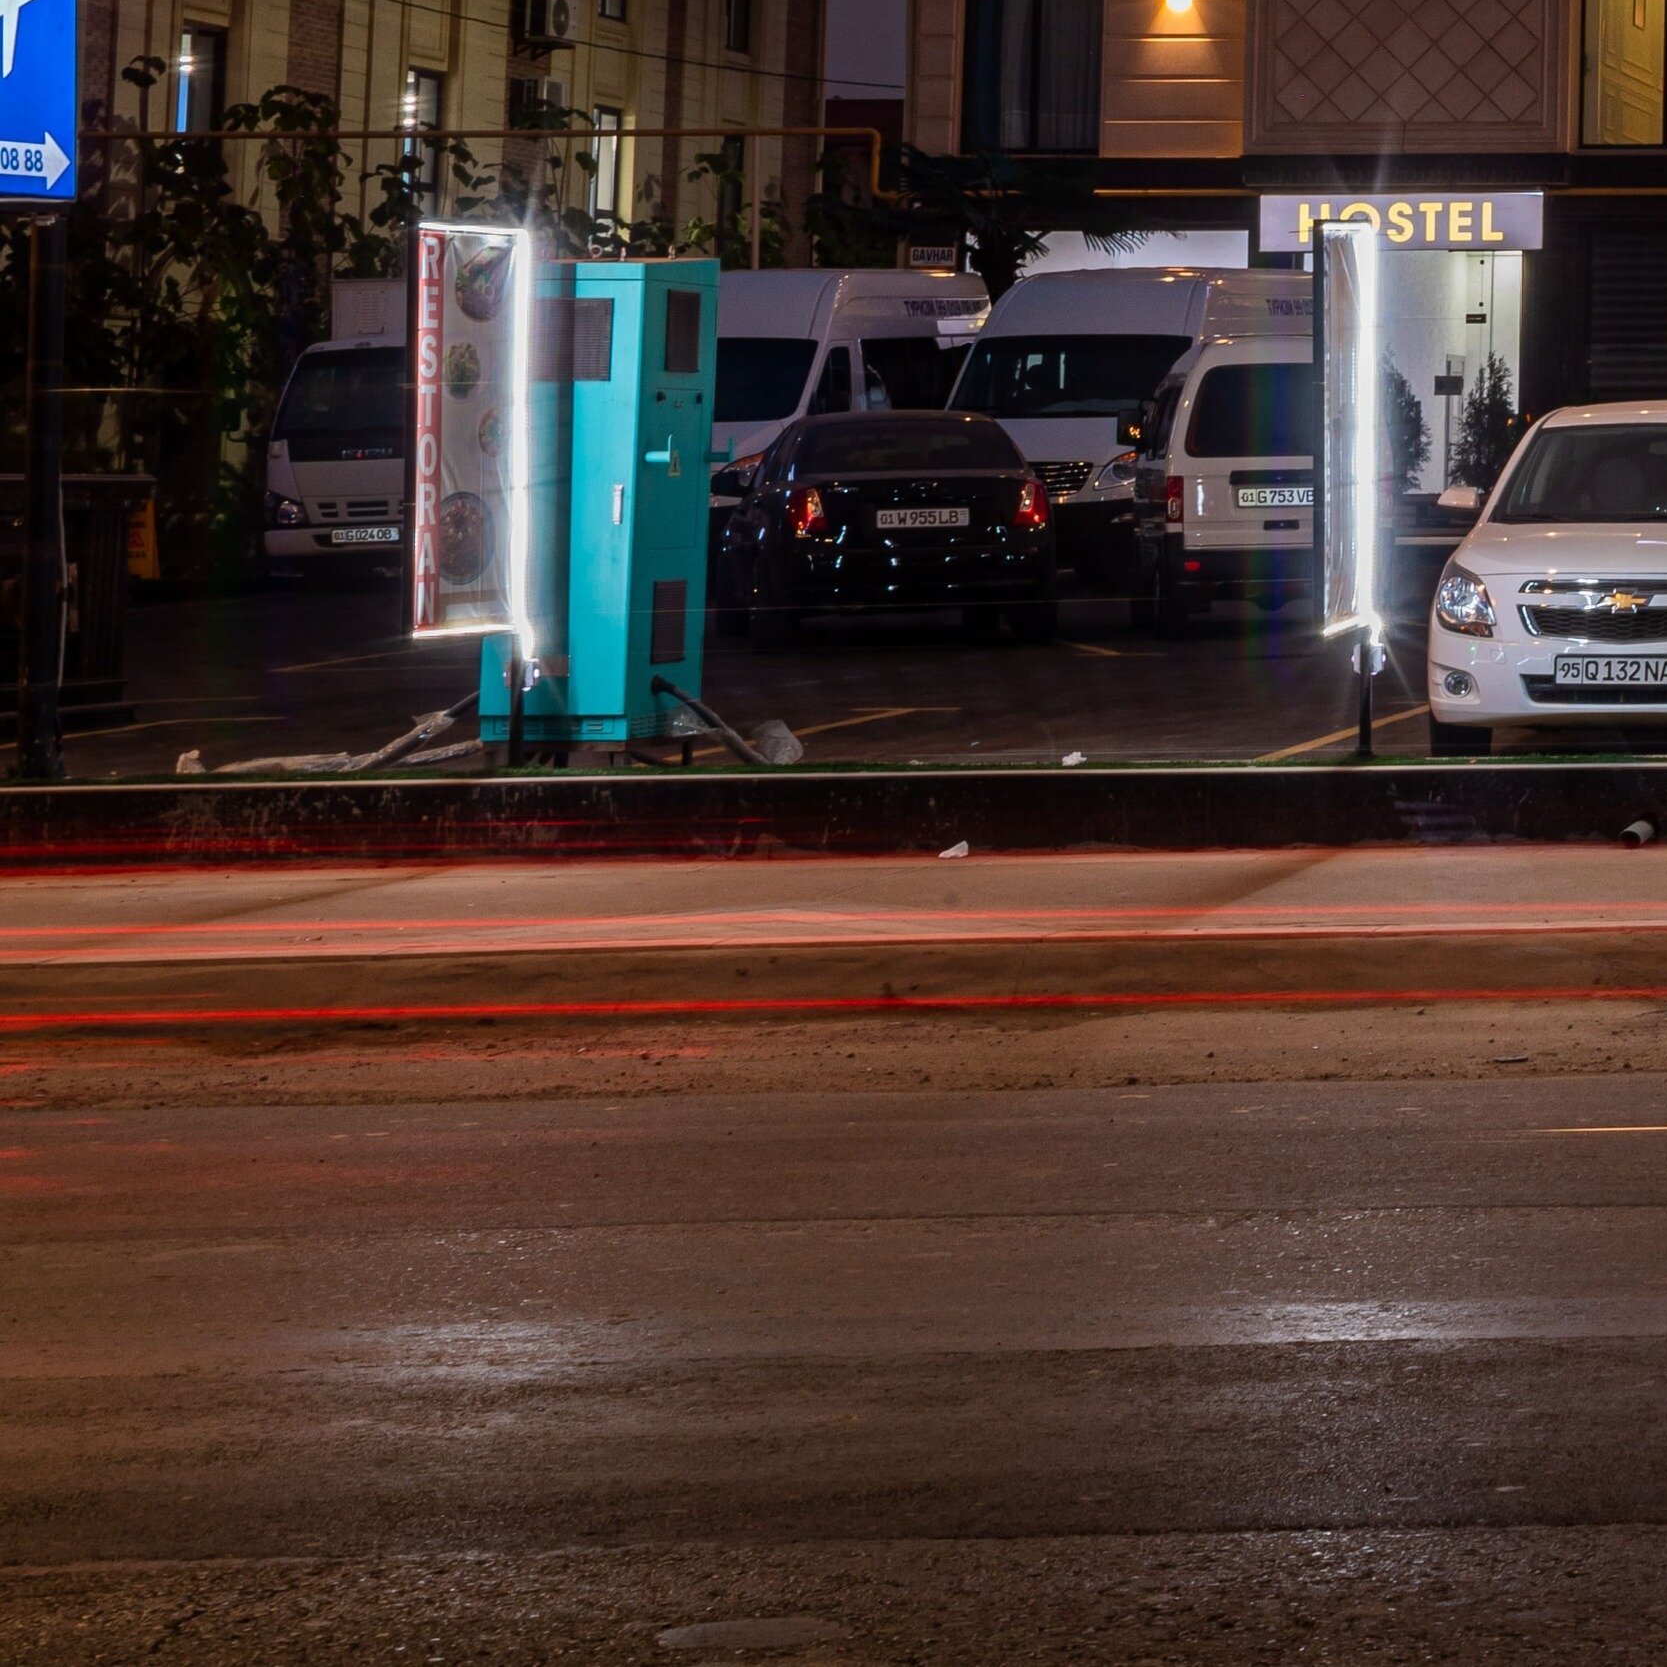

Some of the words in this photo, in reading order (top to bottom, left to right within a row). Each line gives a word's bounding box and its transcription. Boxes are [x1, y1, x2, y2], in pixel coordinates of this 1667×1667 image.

[1, 147, 20, 170] 08
[24, 149, 44, 172] 88
[1298, 202, 1504, 243] HOSTEL
[912, 248, 954, 262] GAVHAR
[415, 236, 444, 625] RESTORAN
